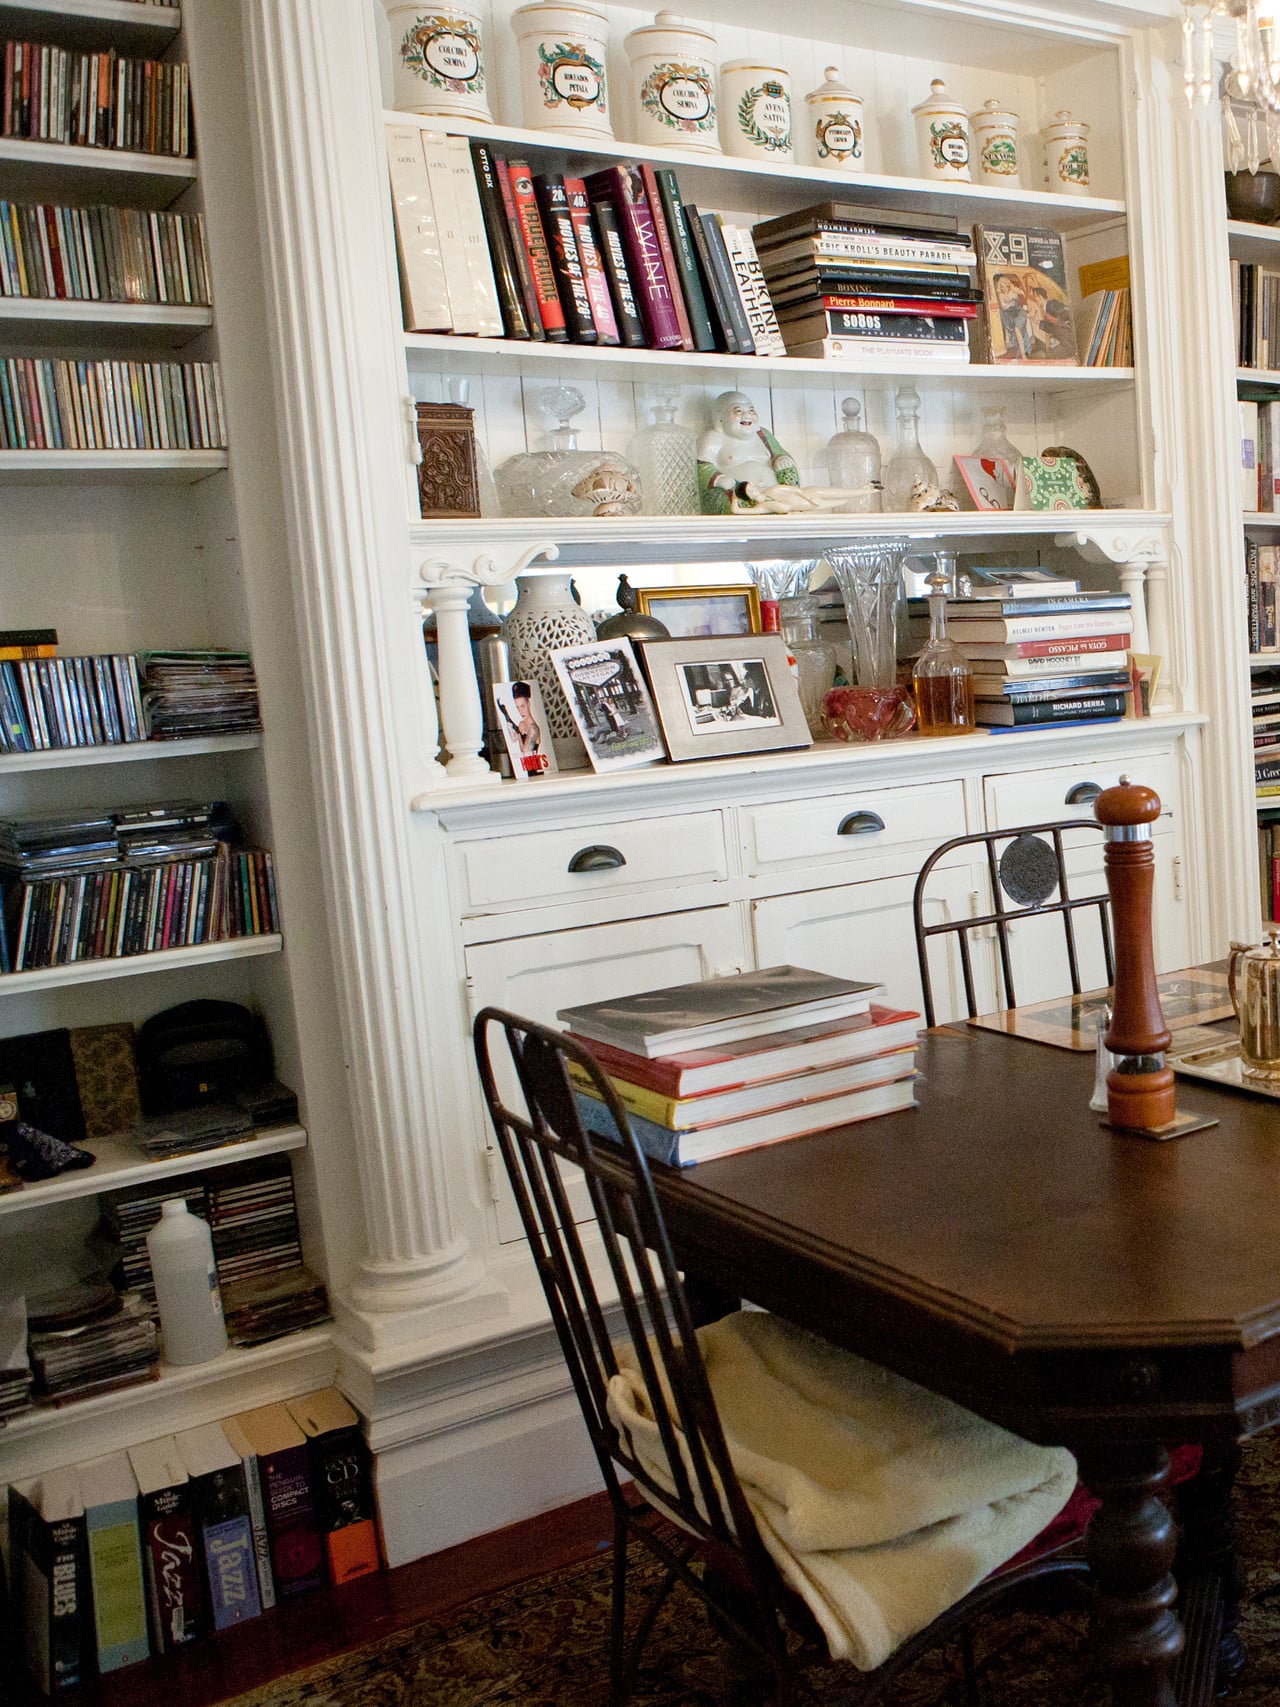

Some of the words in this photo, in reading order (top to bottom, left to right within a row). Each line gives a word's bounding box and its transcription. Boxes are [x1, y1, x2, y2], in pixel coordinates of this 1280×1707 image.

[763, 112, 786, 124] SATIVA
[765, 102, 786, 114] AVENA
[479, 148, 489, 172] OTTO
[485, 173, 494, 188] DIX
[672, 201, 686, 237] Morandi
[557, 218, 579, 261] MOVIES
[577, 224, 599, 267] MOVIES
[658, 222, 670, 253] TURNER
[607, 230, 626, 269] MOVIES
[820, 242, 840, 251] ERIC
[844, 244, 880, 255] KROLL'S
[883, 248, 916, 258] BEAUTY
[920, 251, 952, 261] PARADE
[983, 231, 1030, 266] X-9
[633, 220, 670, 300] WINE
[567, 262, 582, 279] OF
[586, 268, 600, 282] OF
[615, 269, 628, 283] OF
[571, 279, 586, 302] THE
[590, 282, 606, 306] THE
[618, 282, 633, 303] THE
[731, 251, 766, 336] LEATHER
[748, 259, 779, 334] BIKINI
[837, 283, 872, 293] BOXING
[829, 296, 857, 307] Pierre
[858, 298, 895, 309] Bonnard
[876, 347, 911, 355] PLAYMATE
[1034, 625, 1055, 634] NEWTON
[1048, 644, 1079, 654] PICASSO
[1090, 642, 1107, 650] GOYA
[1028, 656, 1044, 665] DAVID
[1053, 701, 1082, 711] RICHARD
[1083, 700, 1105, 708] SERRA
[327, 1463, 360, 1485] CD
[154, 1494, 180, 1506] Music
[271, 1487, 309, 1503] COMPACT
[272, 1498, 298, 1511] DISCS
[255, 1523, 268, 1561] JAZZ
[153, 1522, 193, 1608] Jazz
[53, 1562, 77, 1616] BLUES
